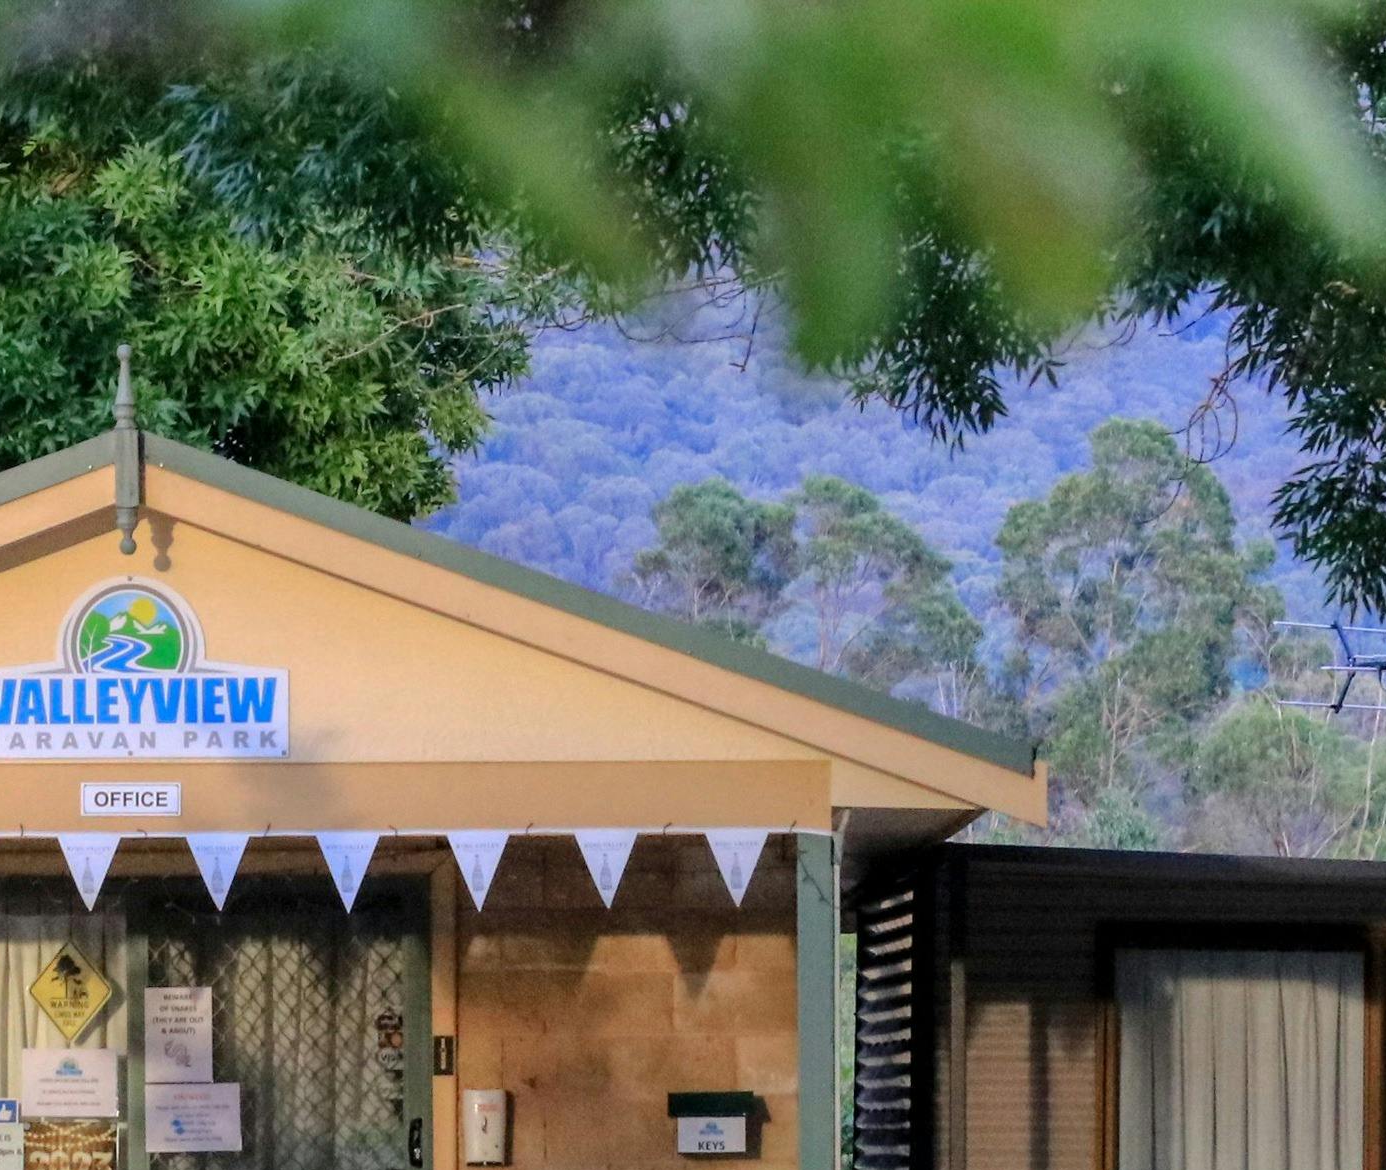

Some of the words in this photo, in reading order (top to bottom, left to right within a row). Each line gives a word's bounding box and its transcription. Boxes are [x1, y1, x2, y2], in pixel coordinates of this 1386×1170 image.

[182, 730, 278, 749] PARK
[94, 791, 169, 808] OFFICE
[697, 1140, 726, 1152] KEYS
